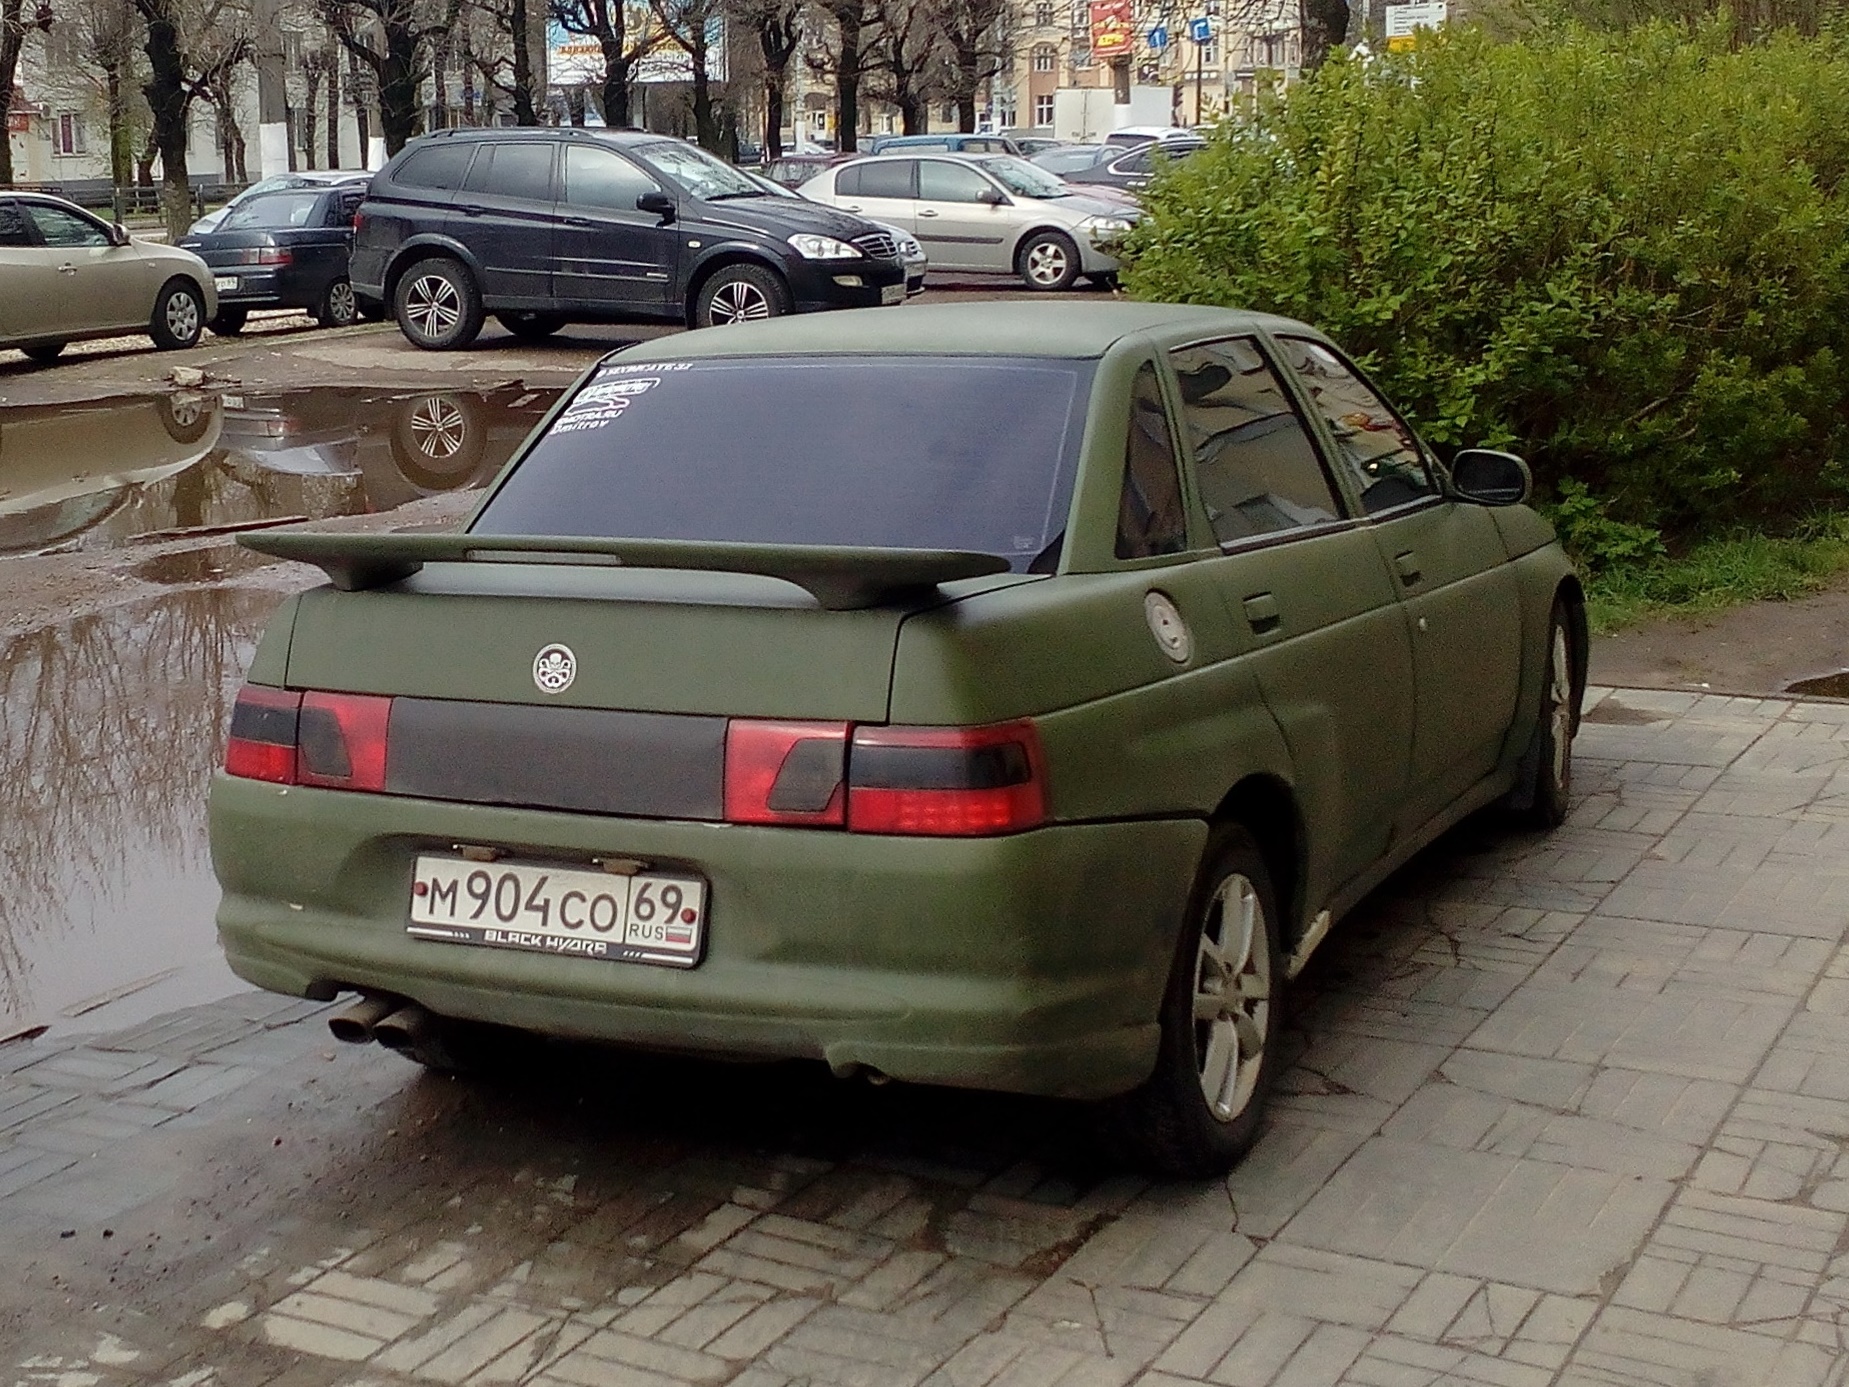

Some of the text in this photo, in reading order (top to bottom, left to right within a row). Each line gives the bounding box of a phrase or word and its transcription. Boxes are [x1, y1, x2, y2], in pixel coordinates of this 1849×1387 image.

[634, 882, 683, 924] 69
[485, 929, 608, 955] BLACK HYDRA
[629, 923, 664, 941] RUS
